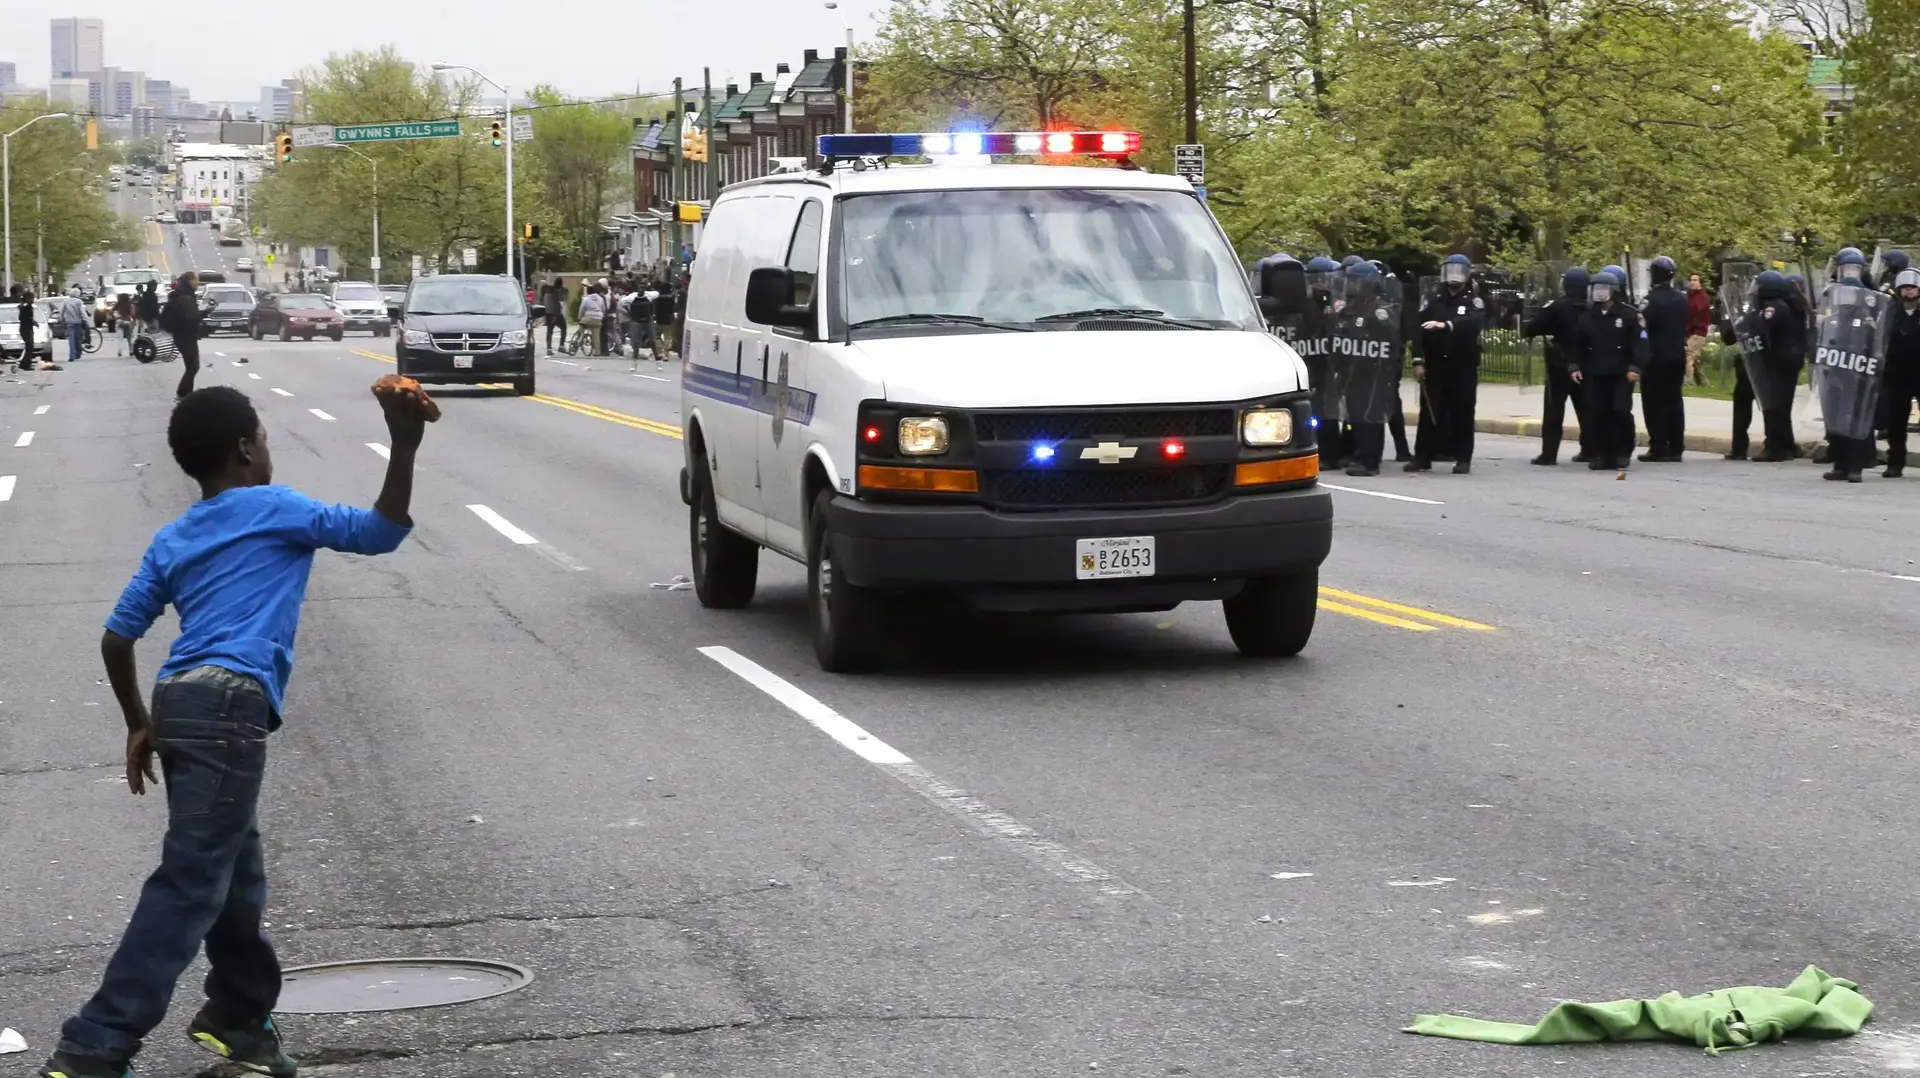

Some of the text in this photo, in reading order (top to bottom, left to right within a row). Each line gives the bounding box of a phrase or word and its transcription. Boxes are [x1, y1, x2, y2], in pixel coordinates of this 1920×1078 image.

[339, 127, 391, 139] GWYNNS
[395, 125, 431, 136] FALLS
[1269, 326, 1296, 340] ICE
[1291, 338, 1330, 356] POLIC
[1332, 336, 1390, 358] POLICE
[1815, 347, 1878, 375] POLICE
[1111, 548, 1151, 568] 2653
